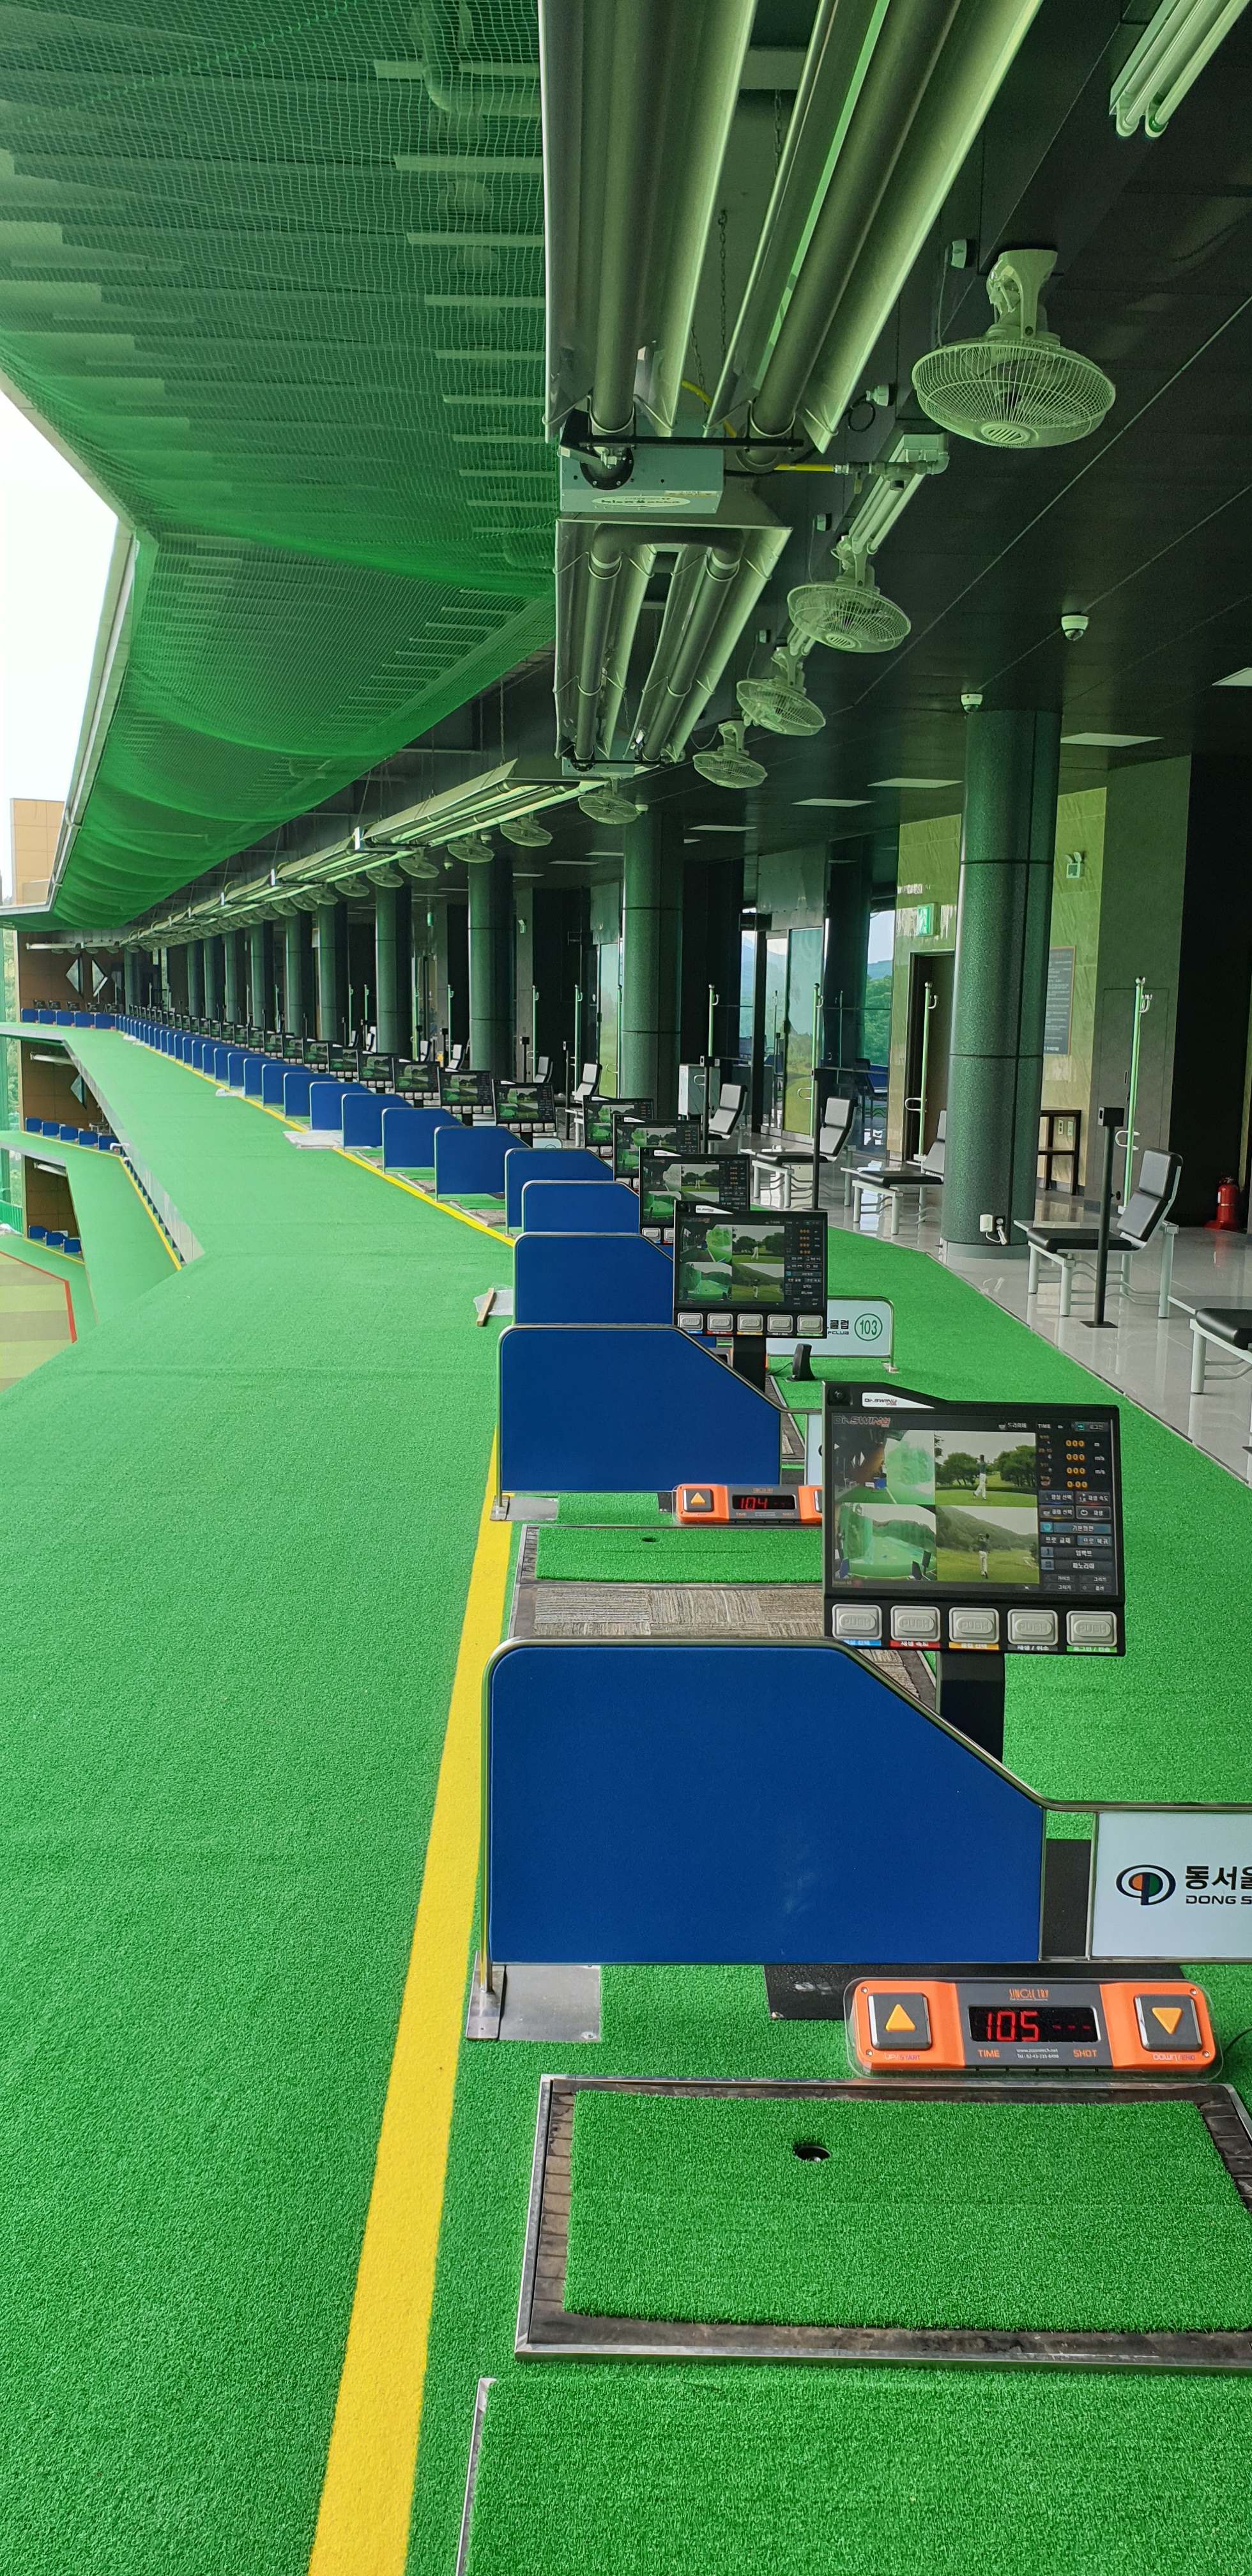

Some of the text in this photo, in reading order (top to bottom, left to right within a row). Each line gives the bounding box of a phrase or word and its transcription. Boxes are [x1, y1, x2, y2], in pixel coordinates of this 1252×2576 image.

[828, 1320, 849, 1329] 클럽
[860, 1320, 877, 1335] 103
[740, 1497, 768, 1510] 104
[1186, 1895, 1237, 1905] DONG
[986, 2010, 1039, 2041] 105
[977, 2049, 1000, 2058] TIME
[1073, 2049, 1097, 2058] SHOT
